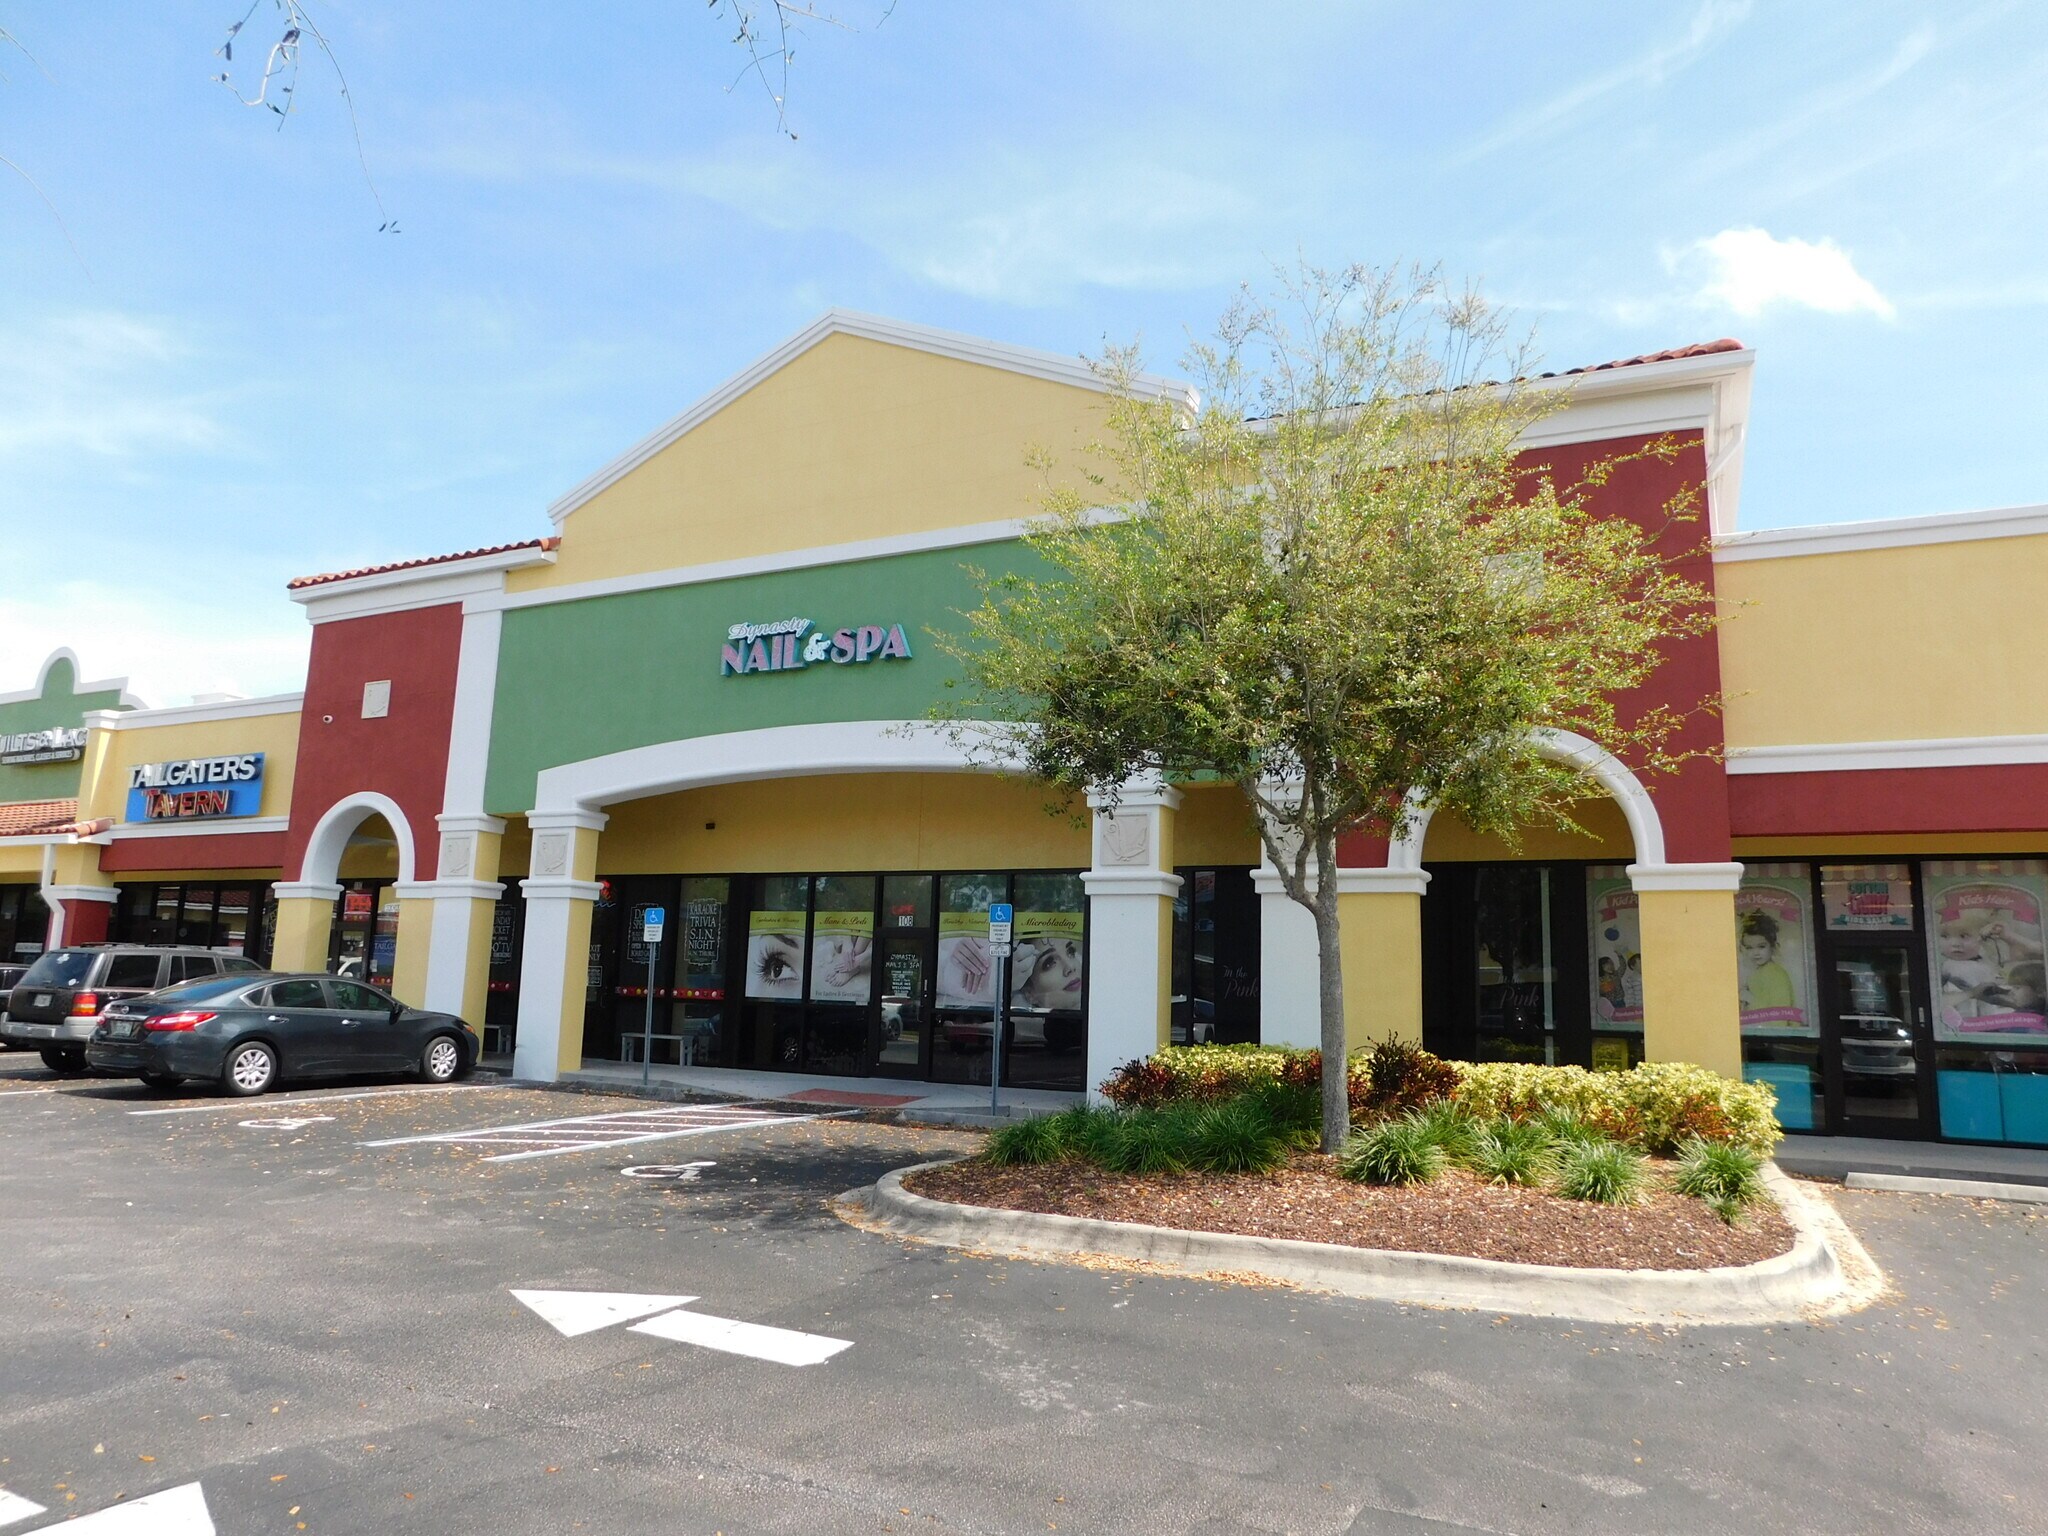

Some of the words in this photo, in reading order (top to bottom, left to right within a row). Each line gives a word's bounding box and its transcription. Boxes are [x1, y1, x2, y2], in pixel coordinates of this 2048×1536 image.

[728, 616, 810, 644] Dynasty
[721, 634, 808, 676] NAIL
[803, 632, 832, 662] &
[830, 623, 912, 664] SPA
[128, 755, 256, 788] TAILGATERS
[142, 788, 231, 818] TAVERN
[1959, 894, 1983, 905] Kids
[1985, 895, 2014, 905] Hair
[690, 916, 716, 927] TRIVIA
[900, 916, 913, 927] 108
[1021, 917, 1077, 928] Microblading
[688, 940, 716, 950] NIGHT
[1224, 977, 1258, 999] Pink
[1499, 984, 1540, 1009] Pink
